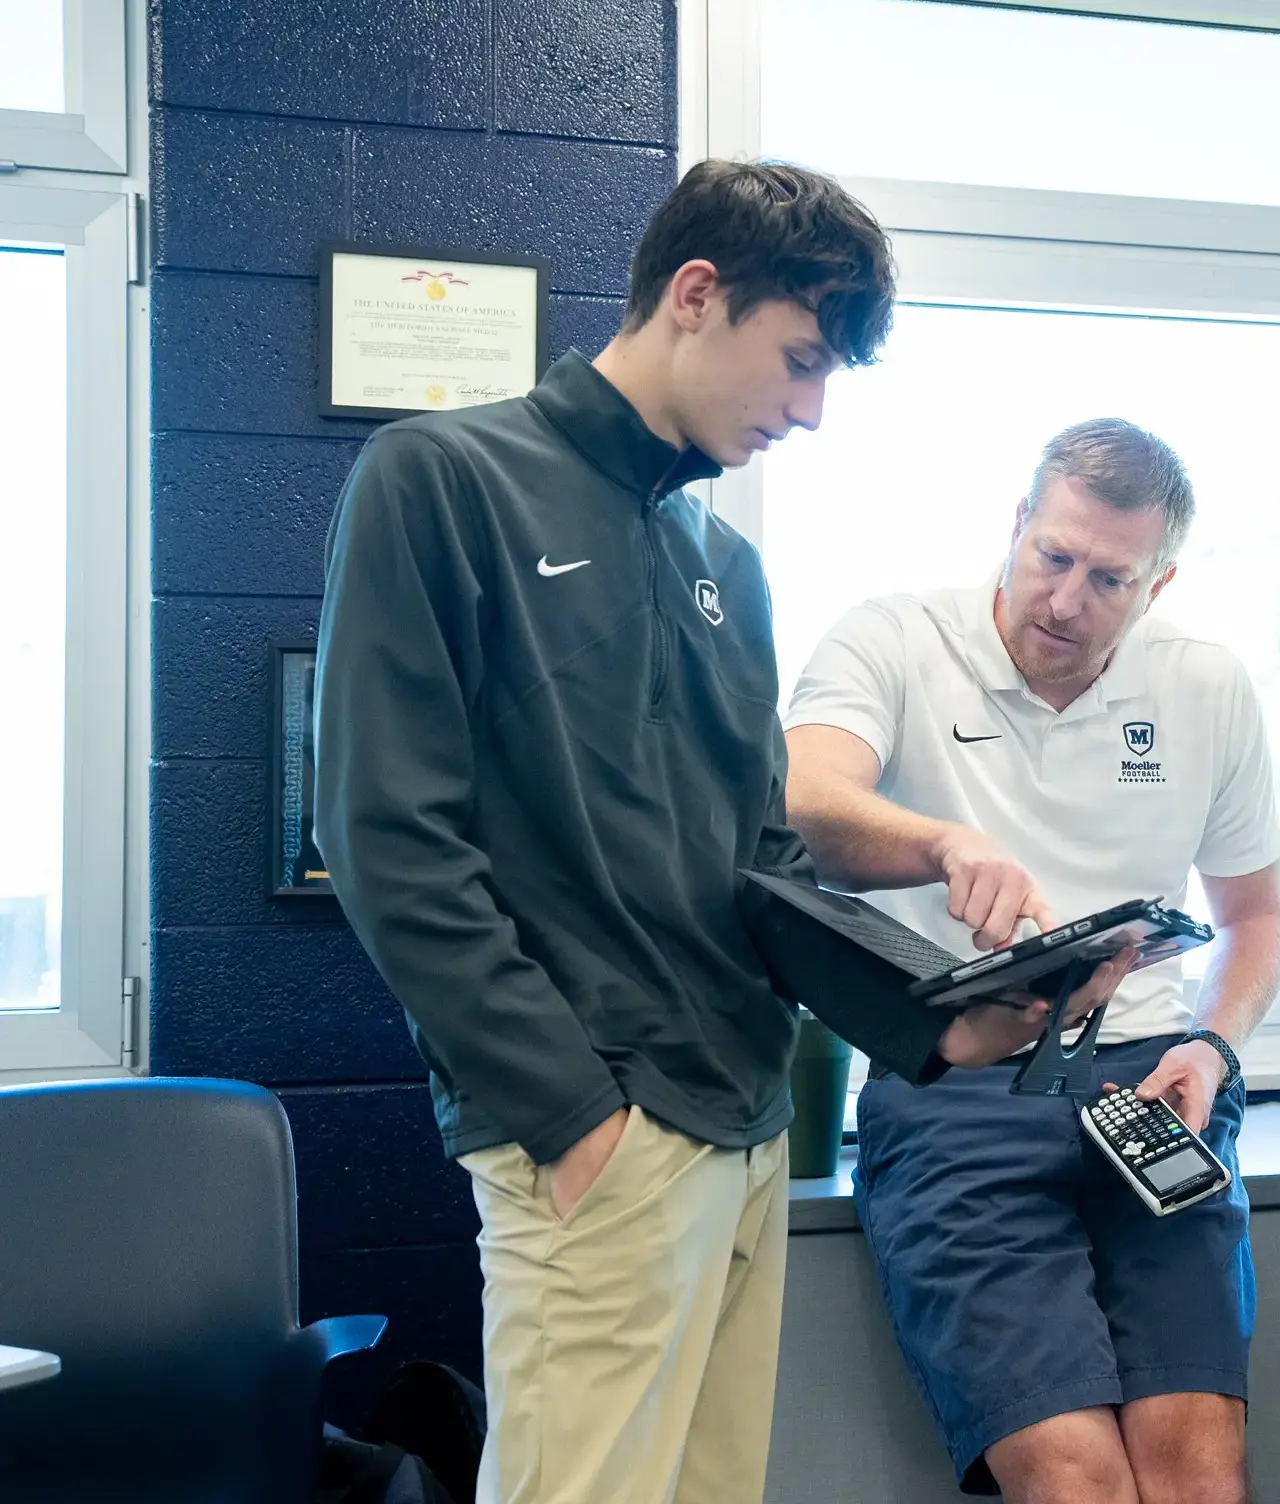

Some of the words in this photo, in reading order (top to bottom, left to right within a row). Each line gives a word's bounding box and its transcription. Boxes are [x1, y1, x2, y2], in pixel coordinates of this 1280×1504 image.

[353, 299, 371, 308] THE
[376, 301, 415, 311] UNITED
[419, 304, 454, 313] STATES
[456, 306, 467, 314] OF
[473, 308, 516, 317] AMERICA
[702, 588, 720, 614] M
[1128, 729, 1149, 745] M
[1121, 760, 1161, 771] Moeller
